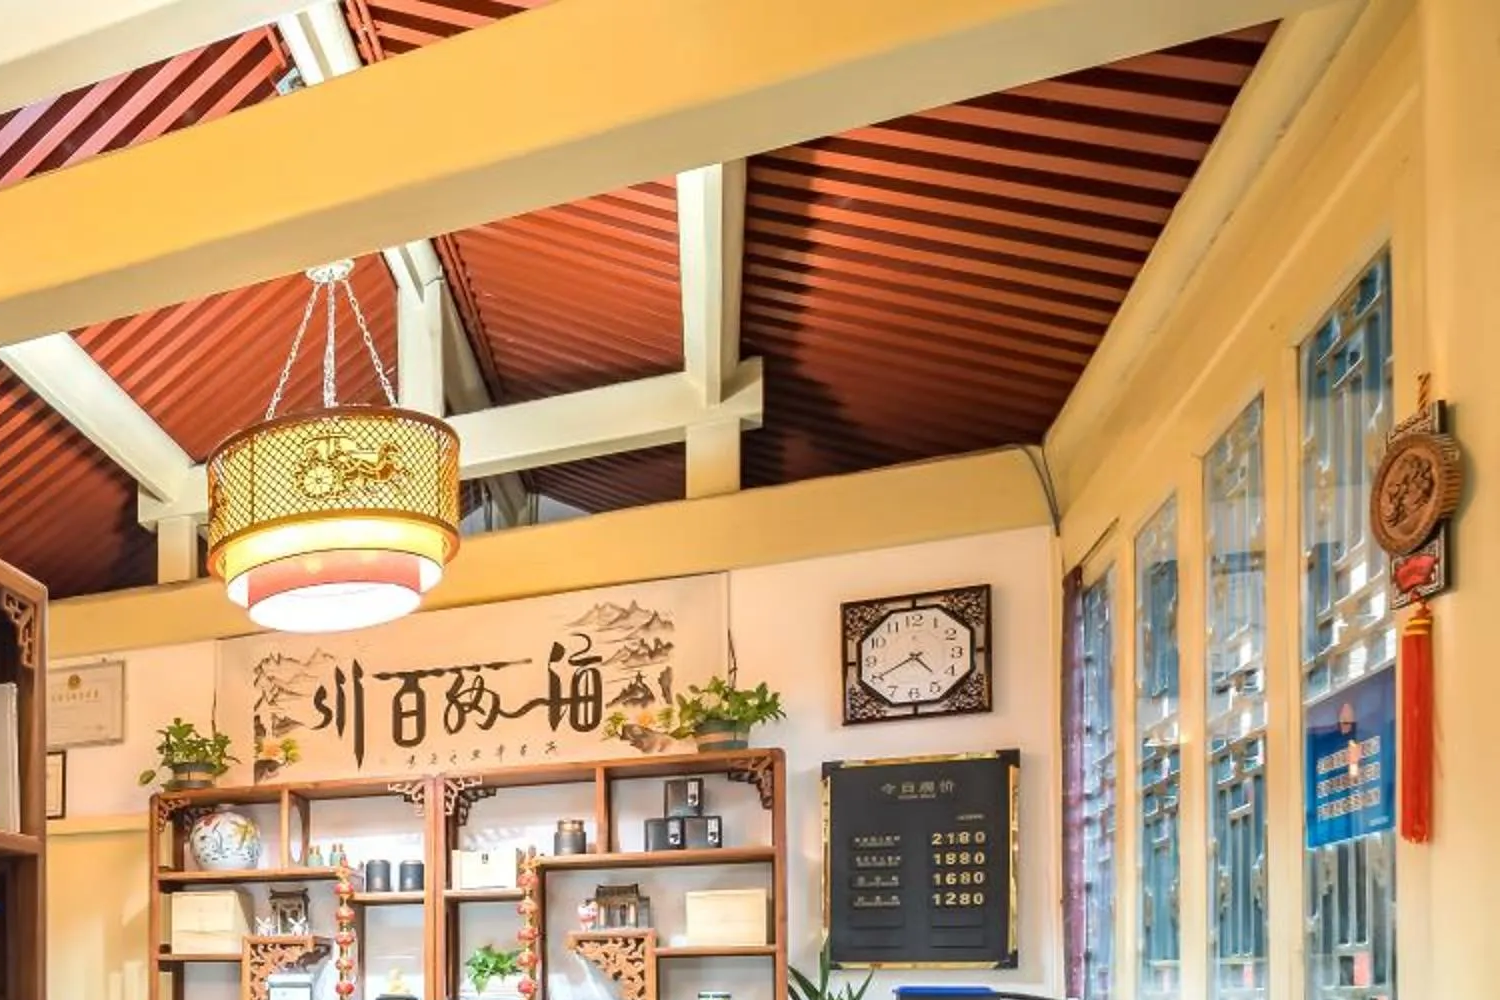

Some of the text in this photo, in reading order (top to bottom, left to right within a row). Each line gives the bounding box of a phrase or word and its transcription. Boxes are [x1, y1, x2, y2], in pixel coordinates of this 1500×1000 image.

[887, 621, 898, 633] 11
[905, 615, 923, 627] 12
[944, 628, 956, 640] 2
[871, 637, 886, 648] 10
[951, 646, 963, 659] 3
[866, 655, 877, 667] 9
[944, 664, 957, 676] 4
[887, 686, 898, 697] 7
[908, 688, 920, 698] 6
[930, 682, 940, 693] 5
[931, 831, 986, 845] 2180
[933, 852, 985, 865] 1880
[933, 871, 985, 885] 1680
[932, 892, 984, 905] 1280
